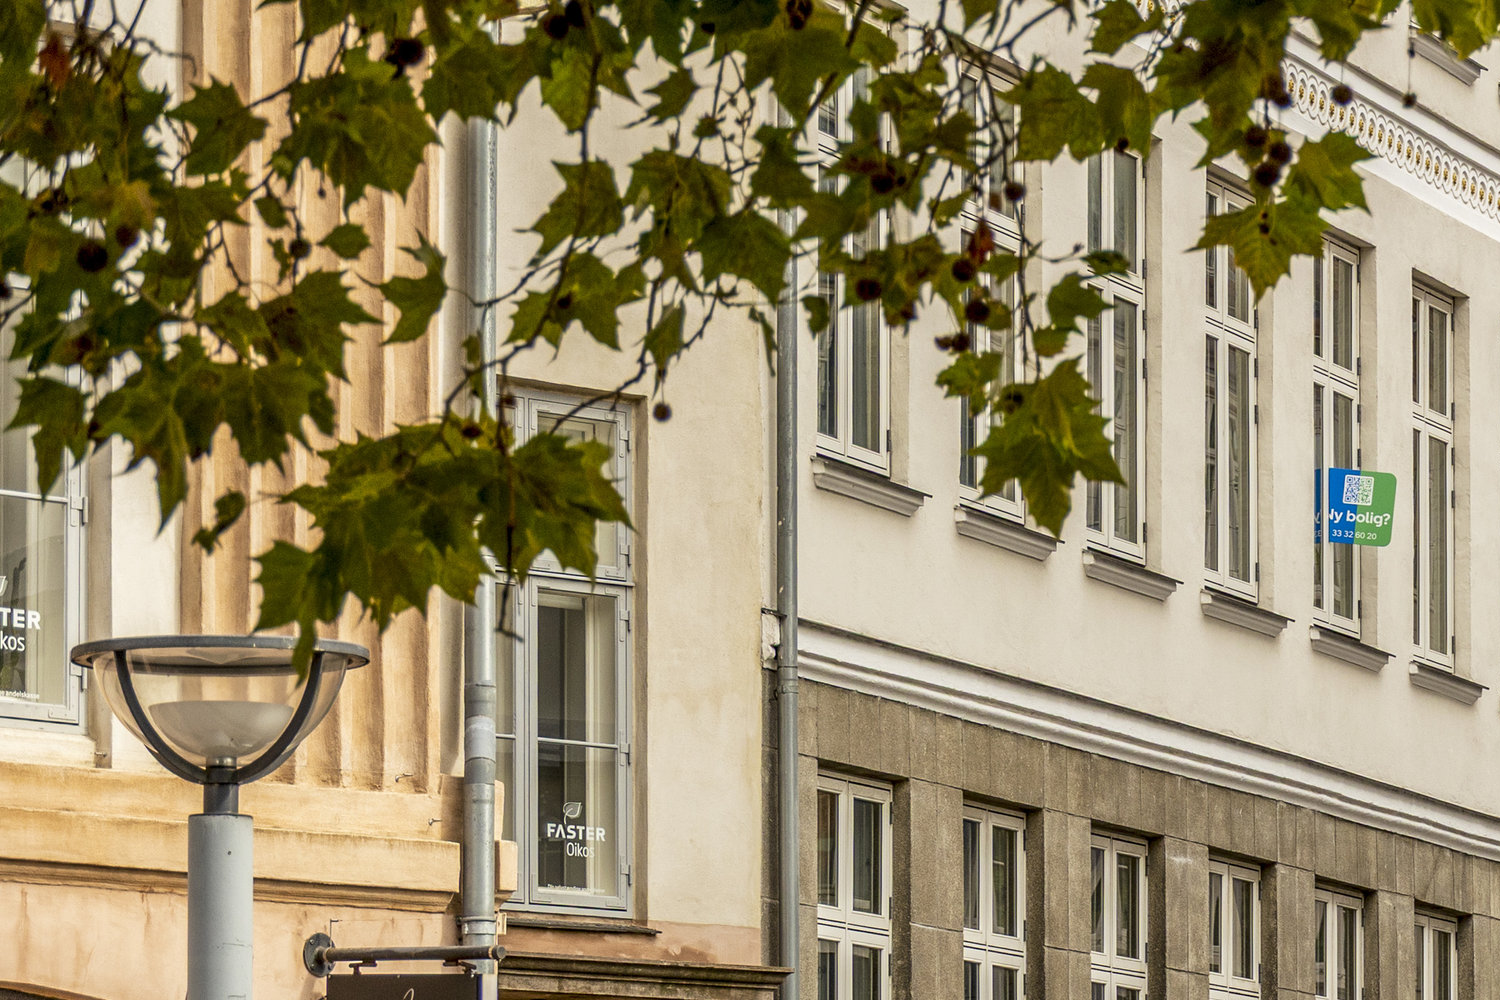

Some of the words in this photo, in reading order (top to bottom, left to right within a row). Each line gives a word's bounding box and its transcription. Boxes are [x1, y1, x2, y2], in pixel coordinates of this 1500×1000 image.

[1346, 510, 1391, 527] bolig?
[1332, 529, 1342, 537] 33
[1344, 530, 1354, 538] 32
[1367, 532, 1377, 540] 20
[0, 607, 41, 629] TER
[547, 823, 606, 841] FASTER
[567, 842, 595, 858] Oikos
